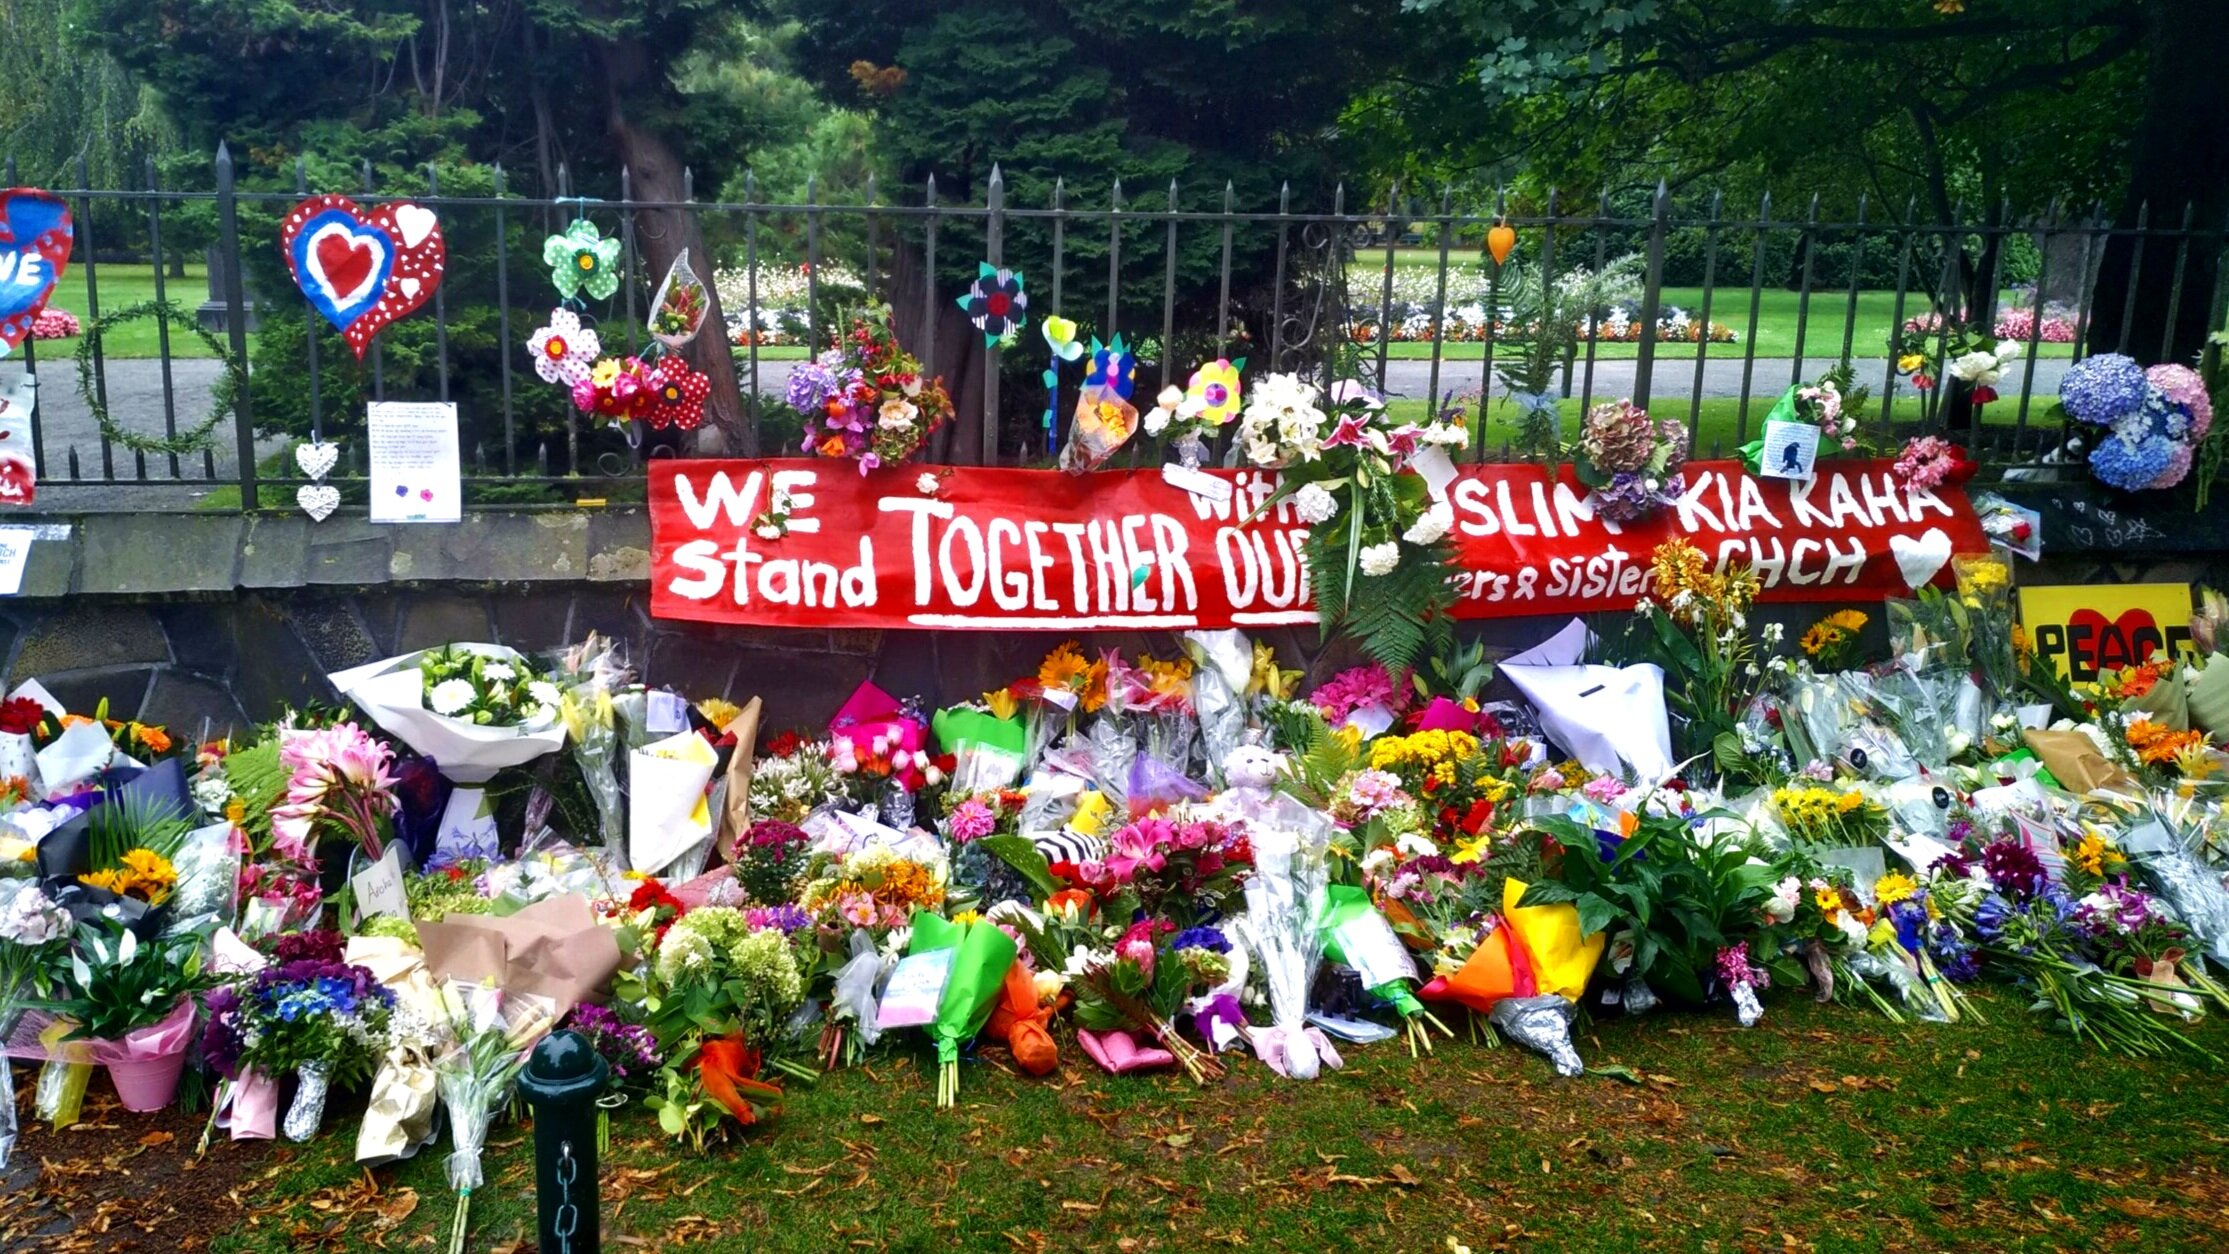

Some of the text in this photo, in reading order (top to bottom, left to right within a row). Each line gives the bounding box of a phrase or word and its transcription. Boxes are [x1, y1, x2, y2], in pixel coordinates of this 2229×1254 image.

[675, 470, 820, 531] WE
[1676, 470, 1954, 533] KIA KAHA
[669, 535, 878, 608] Stand
[1513, 566, 1539, 600] &
[1714, 536, 1867, 588] CHCH
